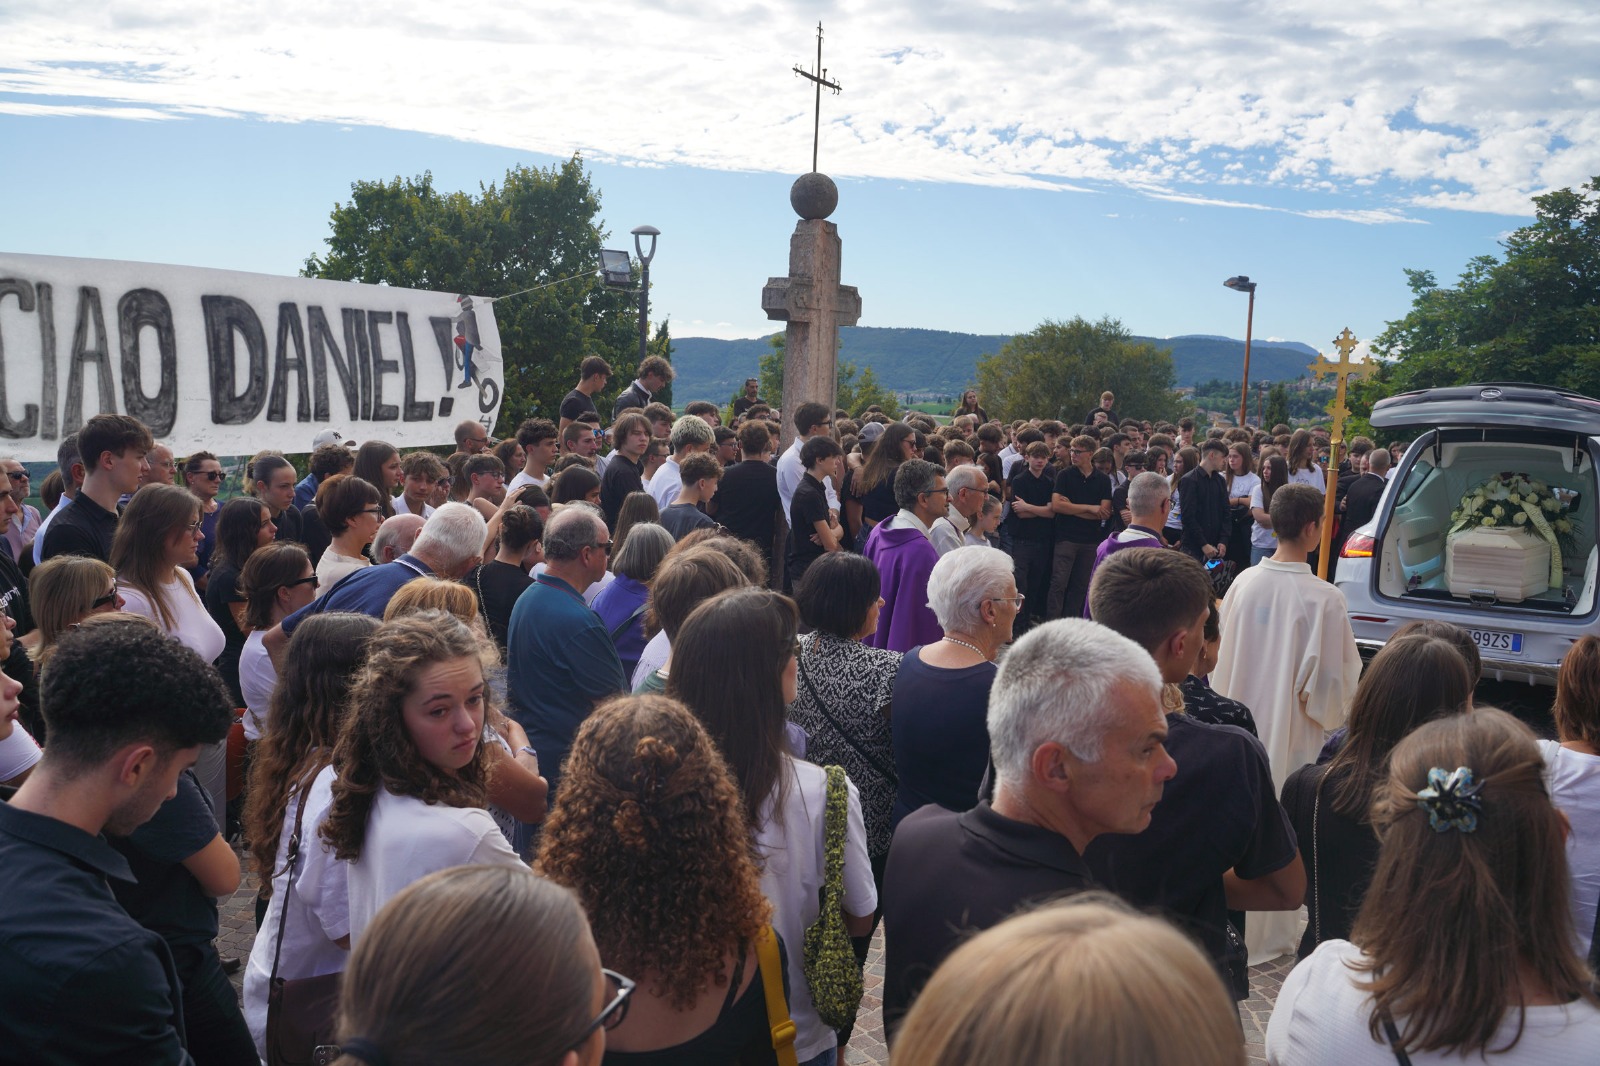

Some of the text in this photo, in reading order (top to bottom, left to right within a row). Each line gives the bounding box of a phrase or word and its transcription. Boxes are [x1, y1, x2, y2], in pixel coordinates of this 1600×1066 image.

[0, 278, 455, 440] CIAO DANIEL!
[1467, 630, 1510, 649] 99ZS
